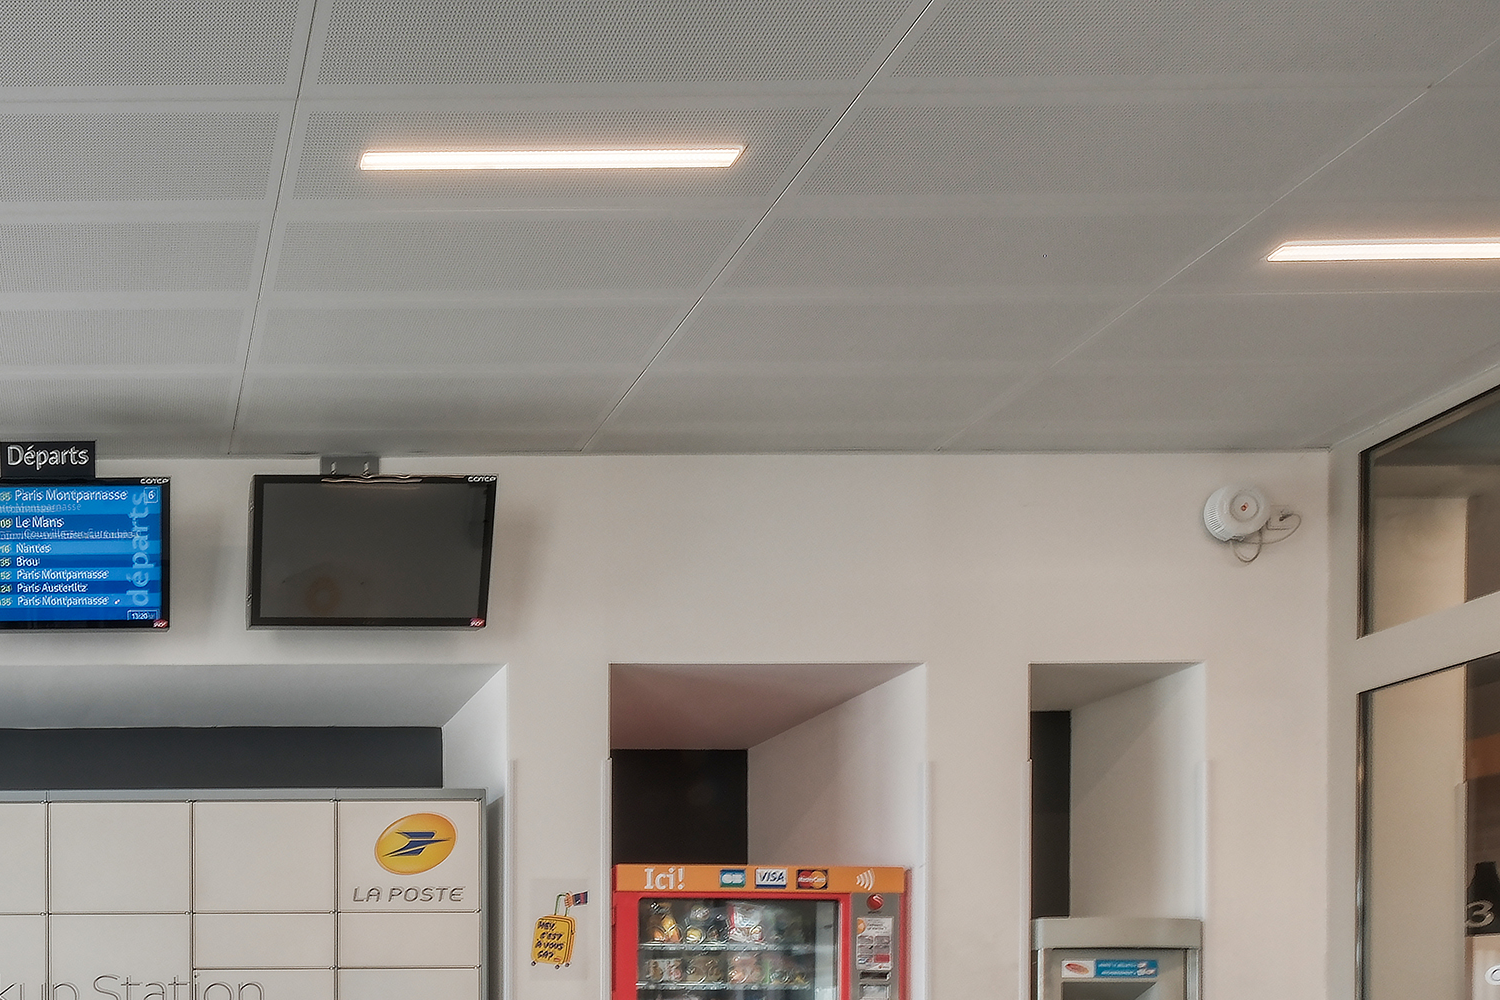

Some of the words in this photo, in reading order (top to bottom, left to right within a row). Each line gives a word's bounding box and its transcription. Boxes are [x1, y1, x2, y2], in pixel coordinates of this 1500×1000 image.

[6, 444, 90, 471] Départs
[15, 488, 44, 501] Paris
[45, 488, 129, 504] Montparnasse
[15, 515, 31, 529] Le
[32, 515, 65, 529] Mans
[16, 542, 52, 554] Nantes
[16, 555, 41, 567] Brou
[16, 568, 41, 580] Paris
[41, 568, 110, 582] Montparnasse
[17, 582, 41, 593] Paris
[41, 581, 90, 593] Austerlitz
[17, 595, 41, 606] Paris
[41, 595, 110, 608] Montparnasse
[644, 867, 686, 890] Ici!
[758, 871, 785, 883] VISA
[352, 886, 383, 902] LA
[387, 886, 466, 902] POSTE
[544, 942, 564, 951] VOUS
